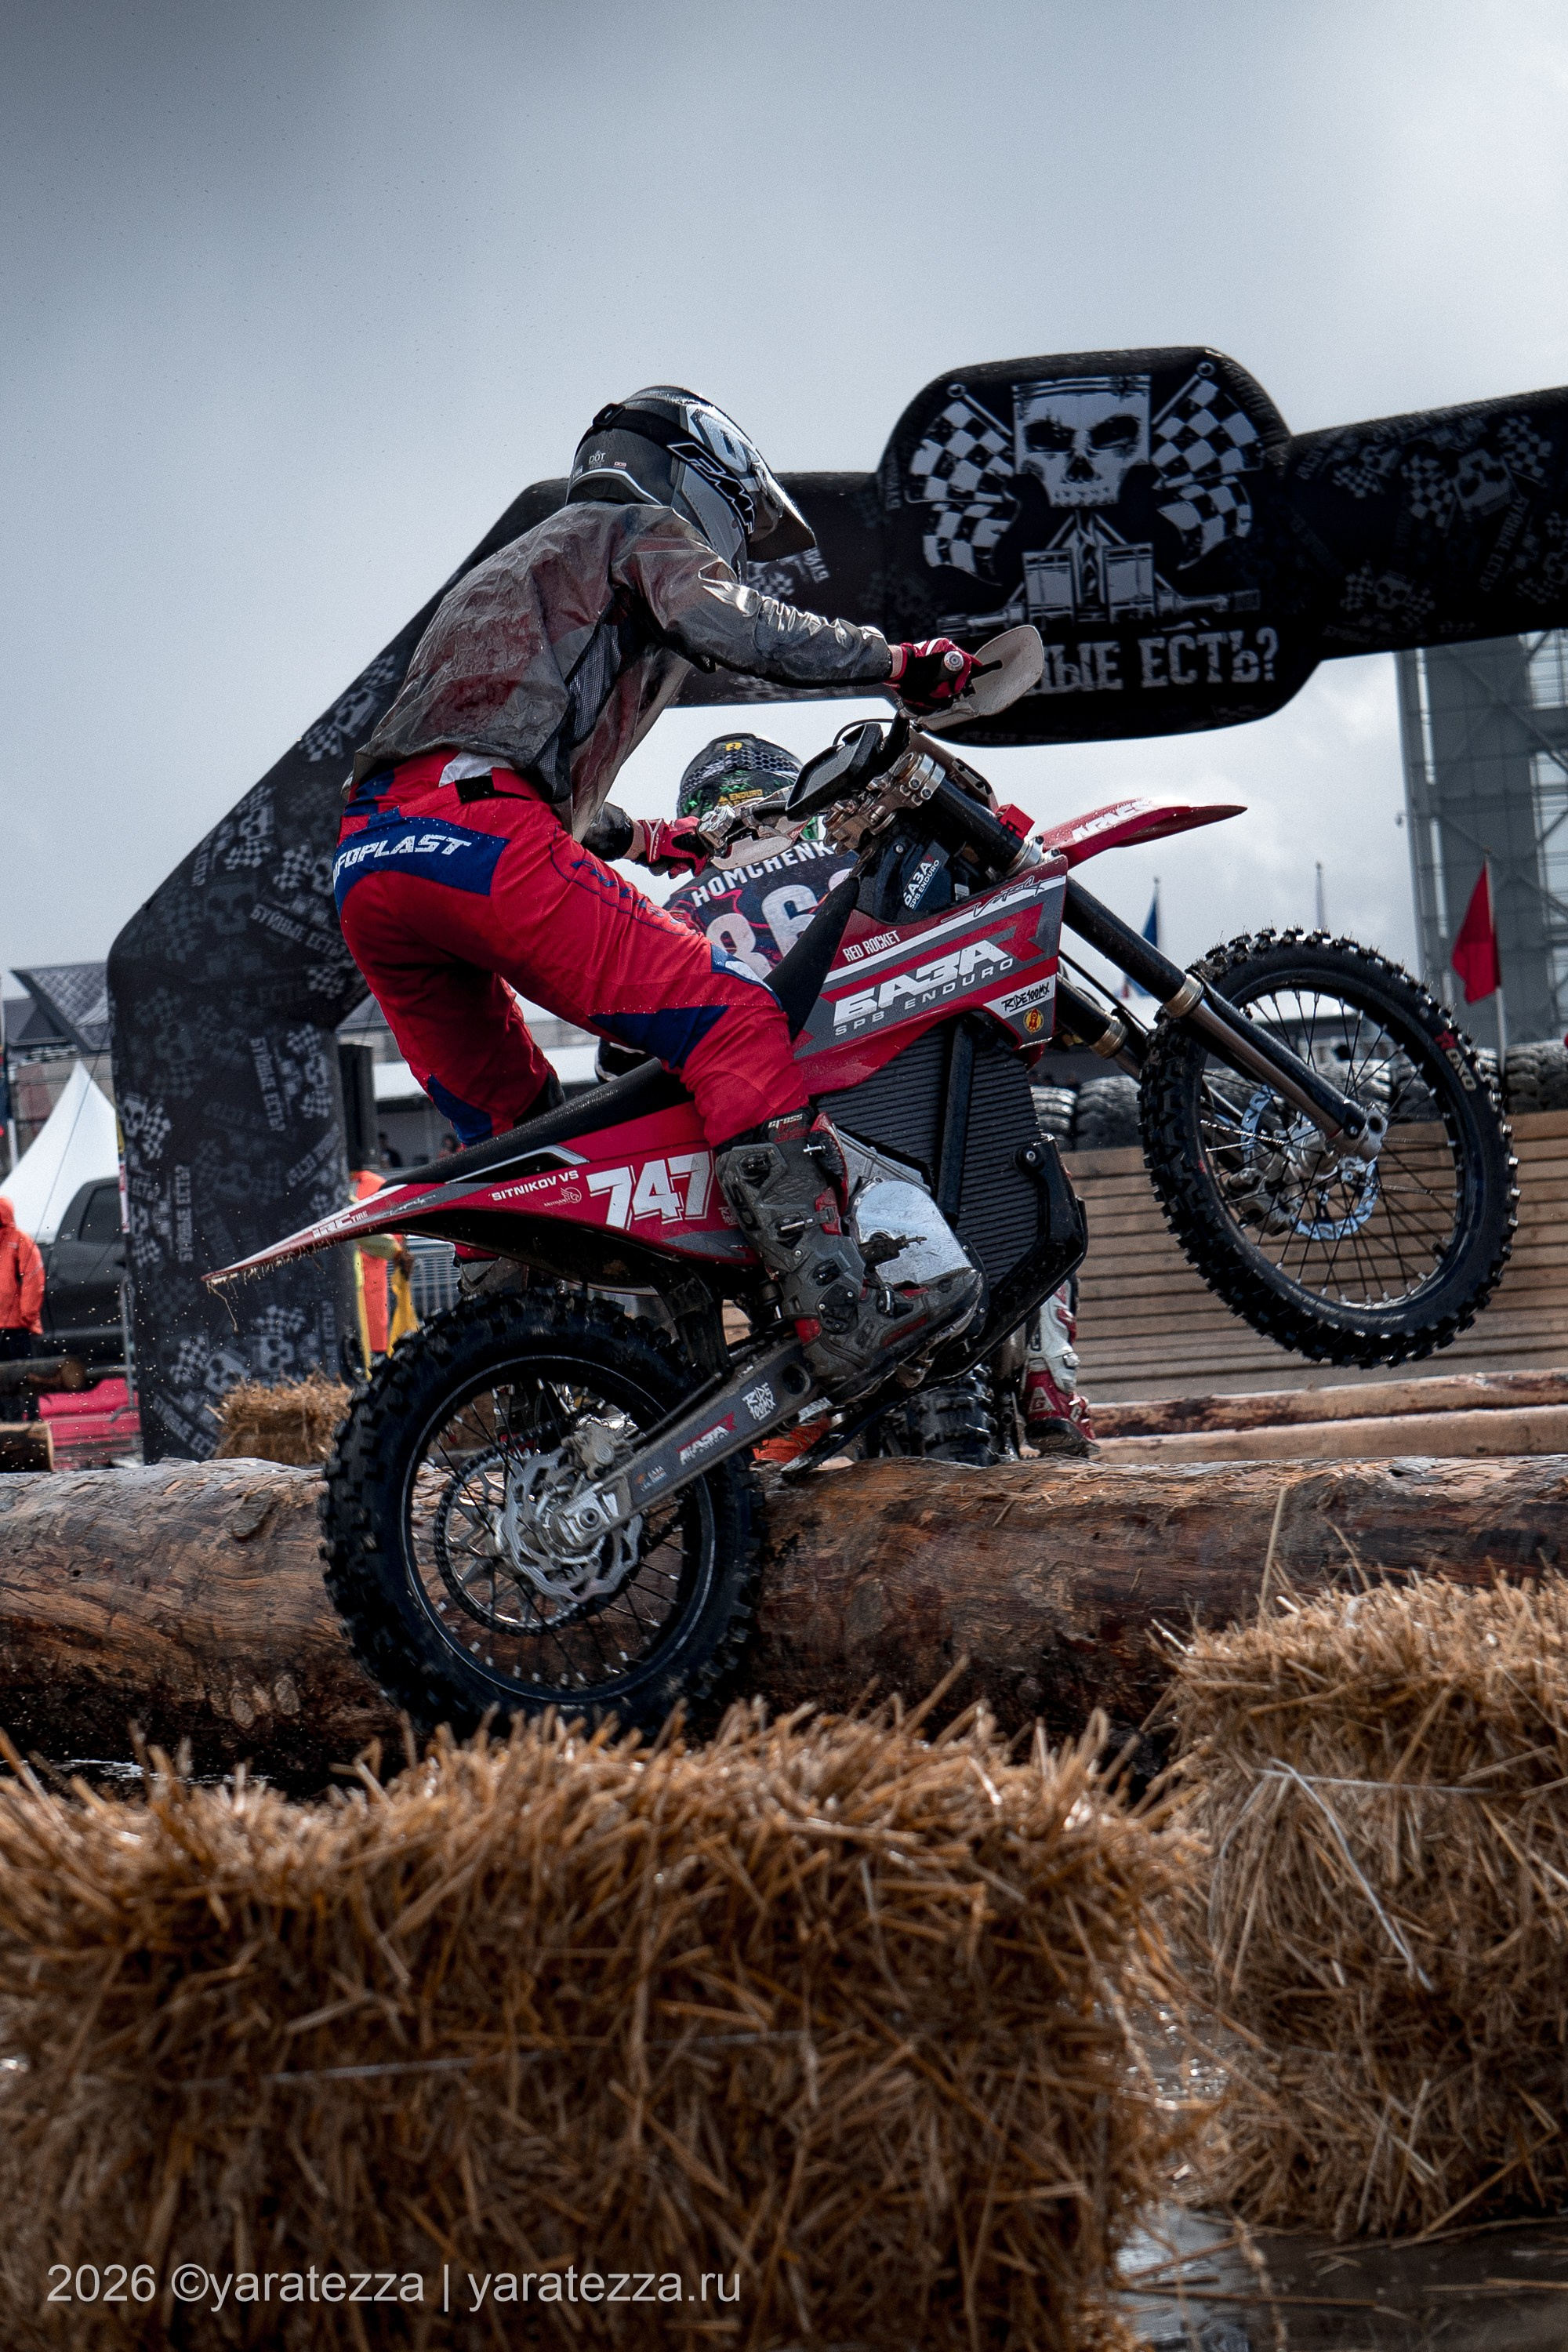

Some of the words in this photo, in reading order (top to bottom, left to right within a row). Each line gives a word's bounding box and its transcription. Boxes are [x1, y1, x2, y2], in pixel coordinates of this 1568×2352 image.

[1137, 626, 1280, 688] ЕСТЬ?
[691, 841, 837, 907] HOMCHENK
[909, 894, 921, 909] SPB
[919, 859, 940, 893] ENDURO
[842, 945, 863, 962] RED
[862, 931, 901, 955] ROCKET
[834, 1011, 884, 1036] SPB
[905, 958, 1013, 1010] ENDURO
[490, 1175, 557, 1202] SITNIKOV
[557, 1170, 579, 1183] VS
[586, 1150, 714, 1230] 747
